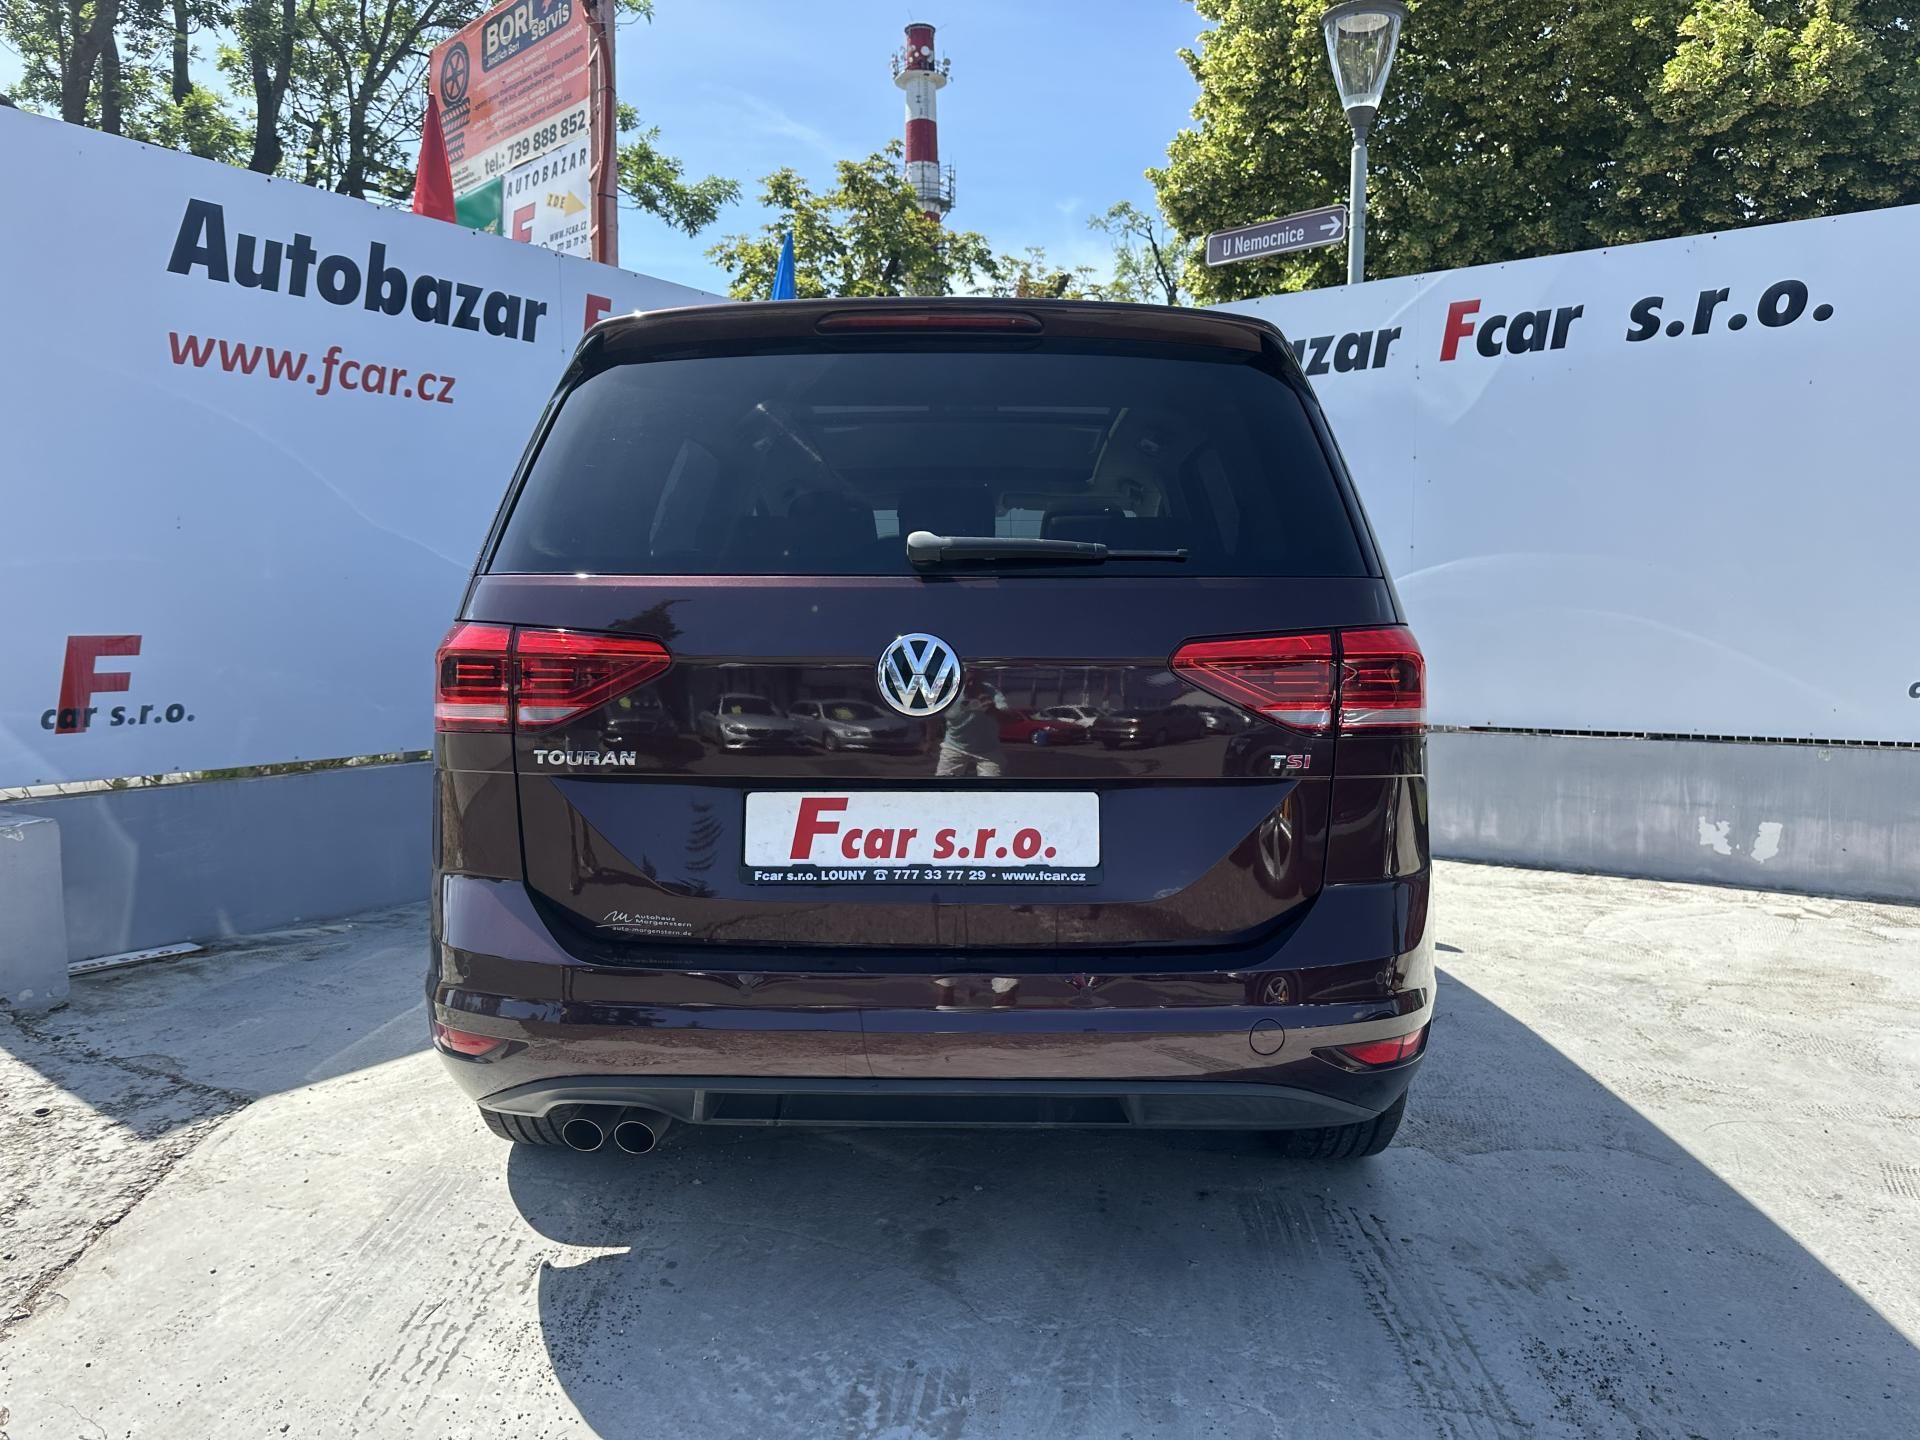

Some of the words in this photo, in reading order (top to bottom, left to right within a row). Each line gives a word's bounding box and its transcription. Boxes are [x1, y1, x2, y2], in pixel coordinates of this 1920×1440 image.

[507, 138, 530, 164] 739
[533, 124, 558, 152] 888
[560, 110, 586, 138] 852
[506, 148, 587, 199] AUTOBAZAR
[1223, 239, 1232, 257] U
[1235, 226, 1305, 255] Nemocnice
[166, 198, 548, 343] Autobazar
[1440, 299, 1585, 362] Fcar
[1625, 278, 1835, 343] s.r.o.
[168, 331, 457, 404] www.fcar.cz
[110, 703, 196, 727] s.r.o.
[533, 749, 638, 766] TOURAN
[1270, 754, 1311, 769] TSI
[789, 796, 918, 860] Fcar
[932, 827, 1057, 860] s.r.o.
[754, 870, 784, 881] Fcar
[786, 871, 817, 881] s.r.o.
[821, 870, 867, 881] LOUNY
[893, 869, 920, 880] 777
[924, 869, 942, 880] 33
[946, 869, 964, 880] 77
[968, 869, 986, 880] 29
[1001, 870, 1086, 881] www.fcar.cz
[612, 926, 692, 937] auto-morgenstern.de
[634, 914, 676, 922] Autohaus
[635, 919, 692, 928] Morgenstern
